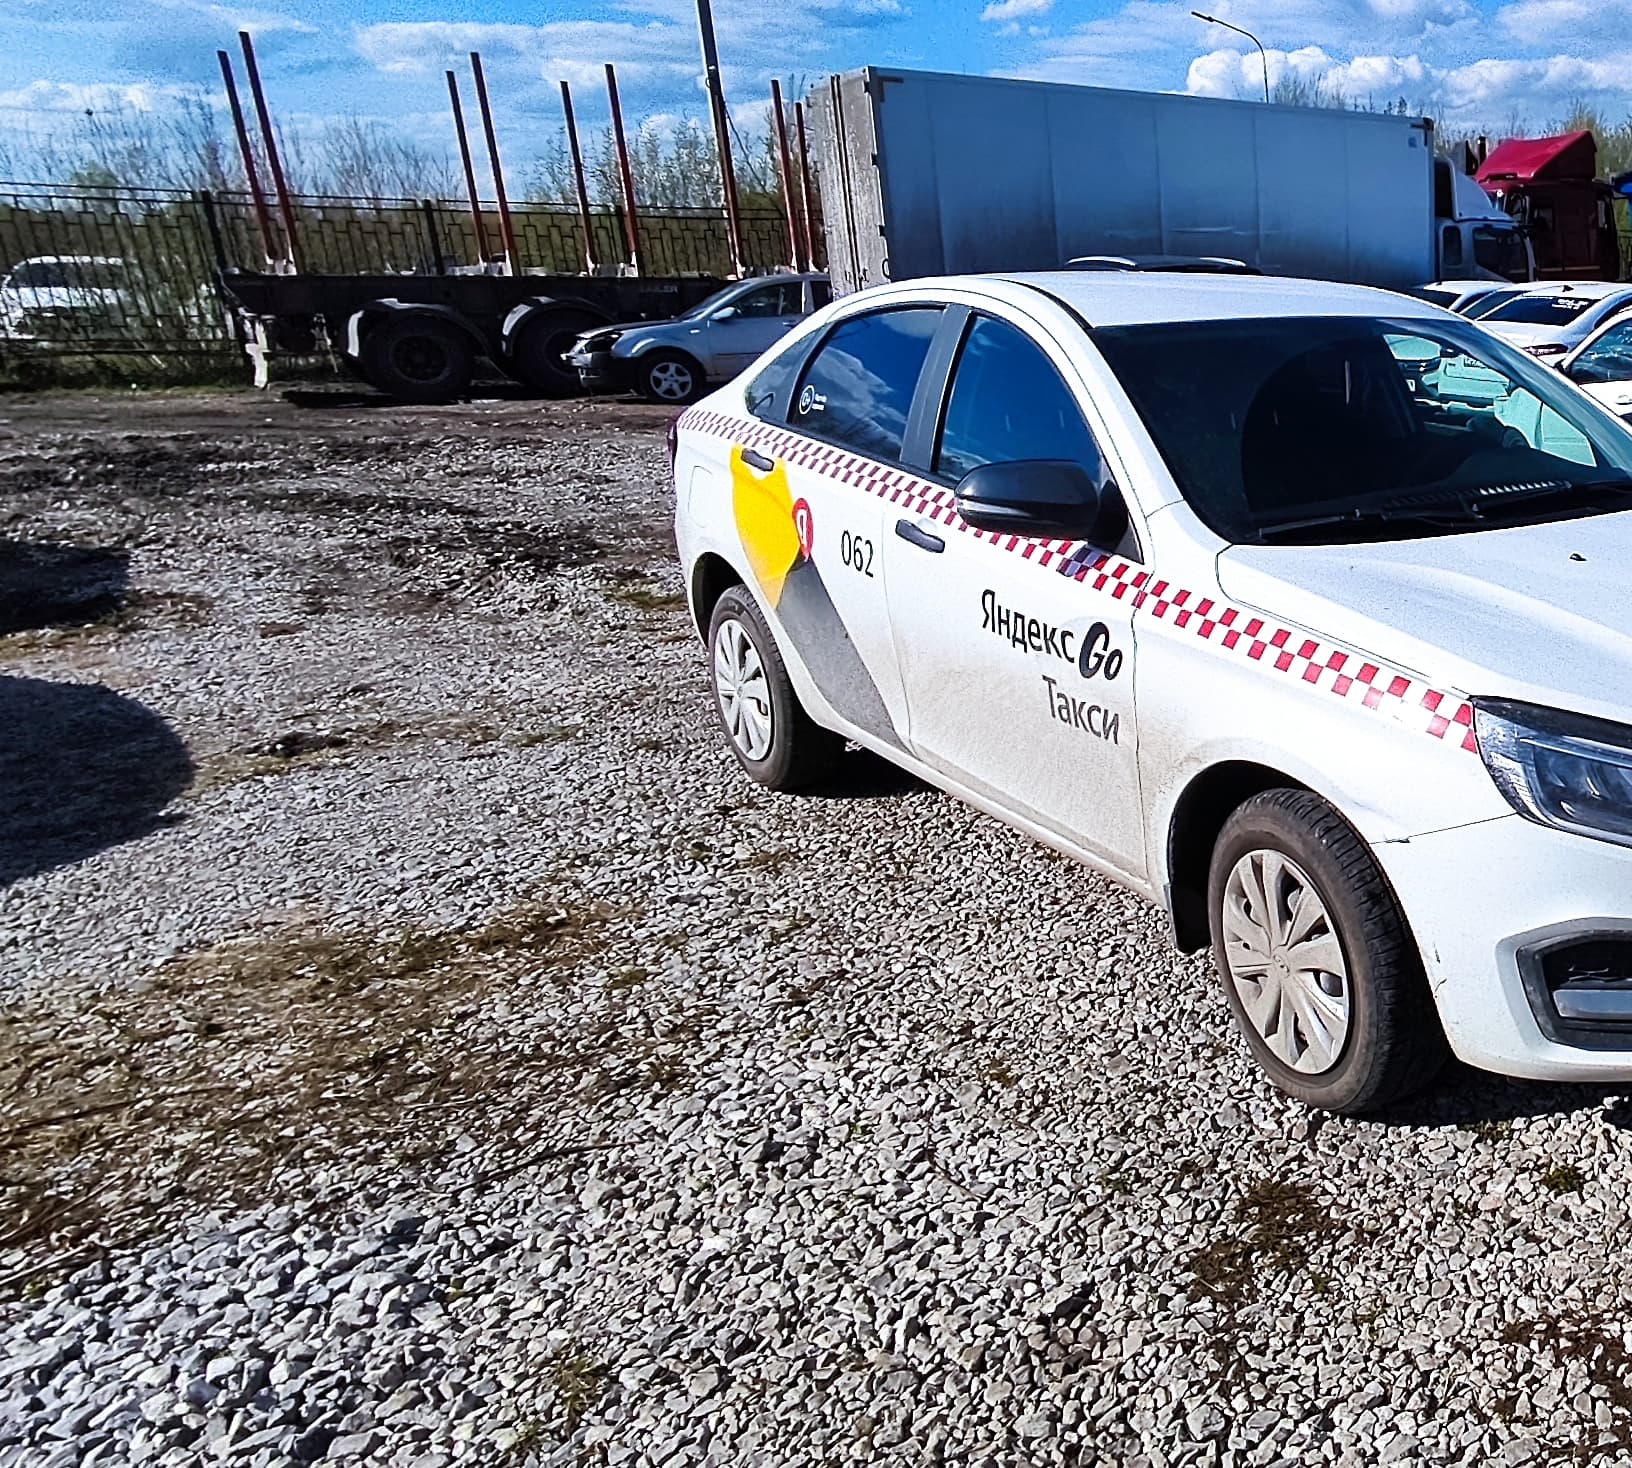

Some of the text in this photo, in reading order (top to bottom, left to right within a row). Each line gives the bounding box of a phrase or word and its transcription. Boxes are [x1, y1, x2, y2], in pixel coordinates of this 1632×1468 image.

[840, 529, 874, 578] 062
[981, 588, 1124, 681] Яндекс Go
[1041, 674, 1120, 745] Такси
